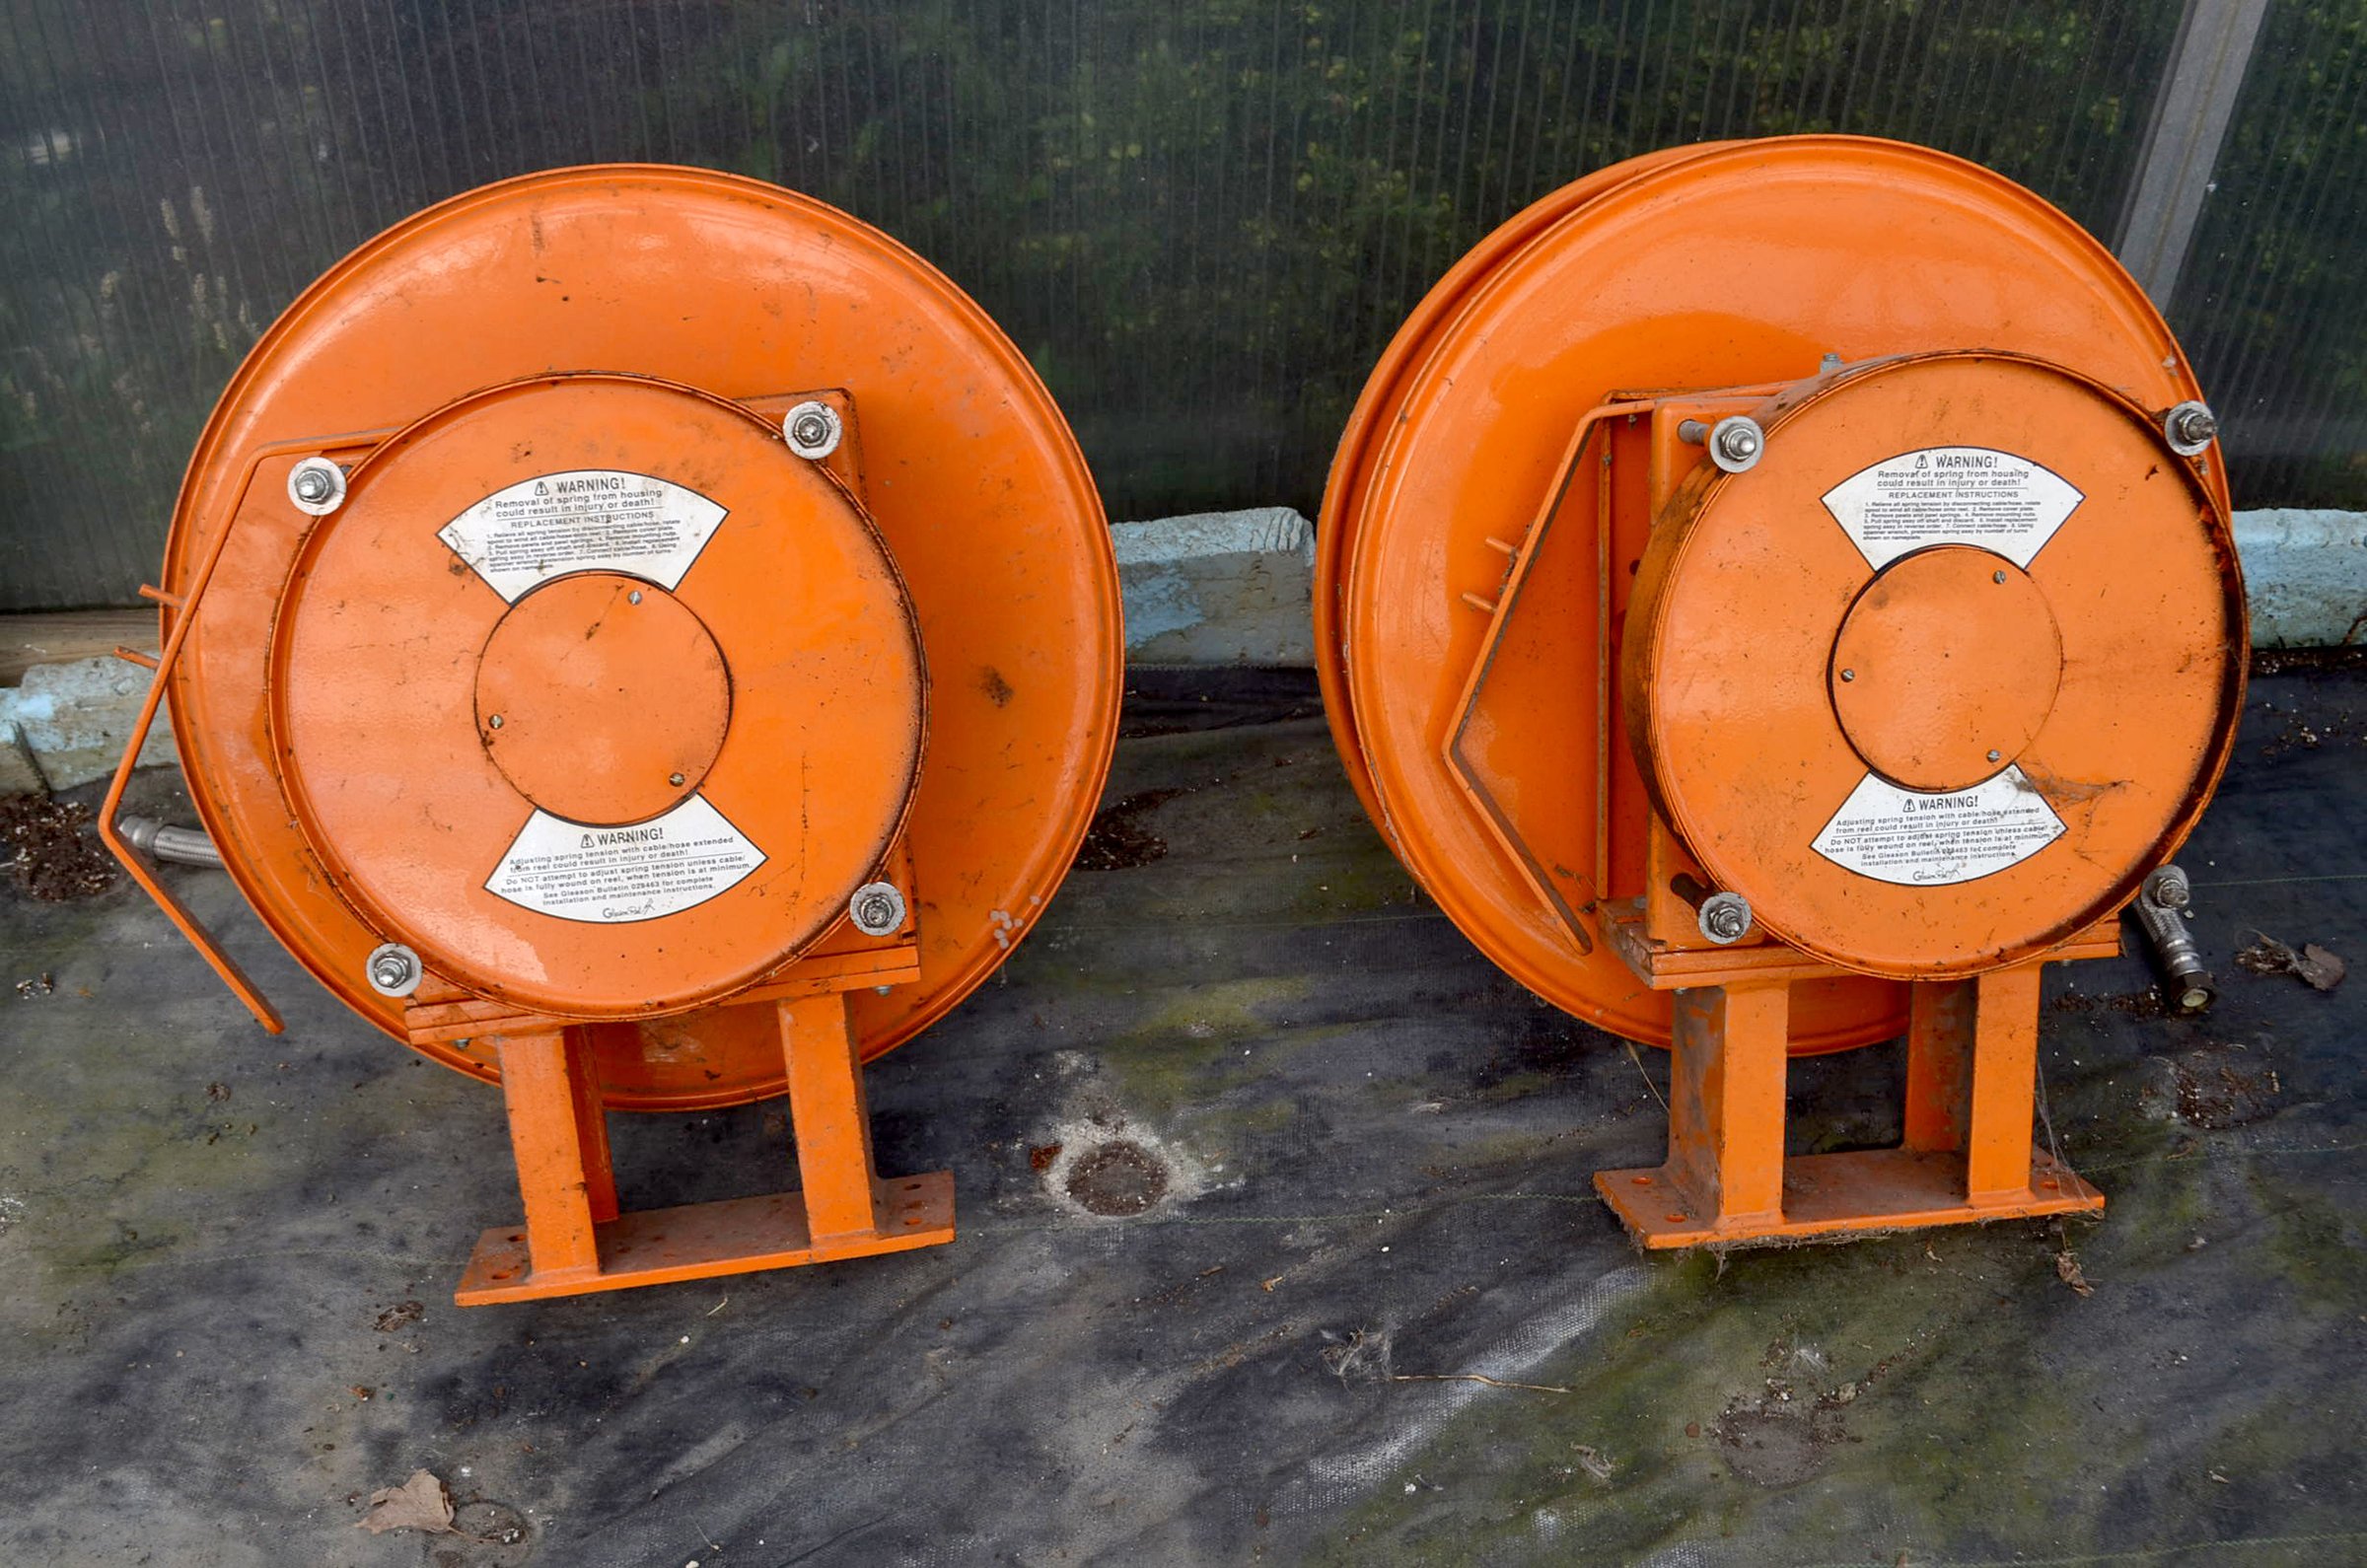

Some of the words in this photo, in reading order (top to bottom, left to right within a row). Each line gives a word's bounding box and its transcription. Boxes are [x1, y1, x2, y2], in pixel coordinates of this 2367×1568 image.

[1936, 456, 1997, 468] WARNING!
[556, 477, 625, 493] WARNING!
[1949, 479, 1975, 487] injury
[495, 498, 540, 508] Removal
[557, 495, 590, 504] spring
[620, 489, 662, 498] housing
[496, 508, 525, 517] could
[574, 503, 604, 512] injury
[622, 498, 654, 507] death!
[511, 517, 580, 528] REPLACEMENT
[584, 511, 654, 523] INSTRUCTIONS
[1919, 796, 1978, 810] WARNING!
[1836, 818, 1875, 827] Adjusting
[1878, 817, 1903, 825] spring
[1936, 820, 1959, 828] injury
[597, 828, 663, 845] WARNING!
[509, 856, 552, 865] Adjusting
[554, 852, 583, 860] spring
[585, 849, 619, 858] tension
[622, 845, 640, 853] with
[693, 837, 733, 846] extended
[580, 858, 606, 866] result
[620, 853, 645, 862] injury
[660, 849, 688, 857] death!
[1921, 854, 1968, 862] maintenance
[542, 872, 576, 882] attempt
[590, 867, 618, 877] adjust
[621, 865, 649, 874] spring
[652, 861, 685, 870] tension
[687, 858, 717, 867] unless
[558, 879, 587, 887] wound
[626, 872, 650, 881] when
[652, 870, 685, 878] tension
[561, 888, 593, 897] Gleason
[597, 884, 628, 893] Bulletin
[676, 876, 713, 885] complete
[543, 896, 589, 906] installation
[609, 889, 661, 900] maintenance
